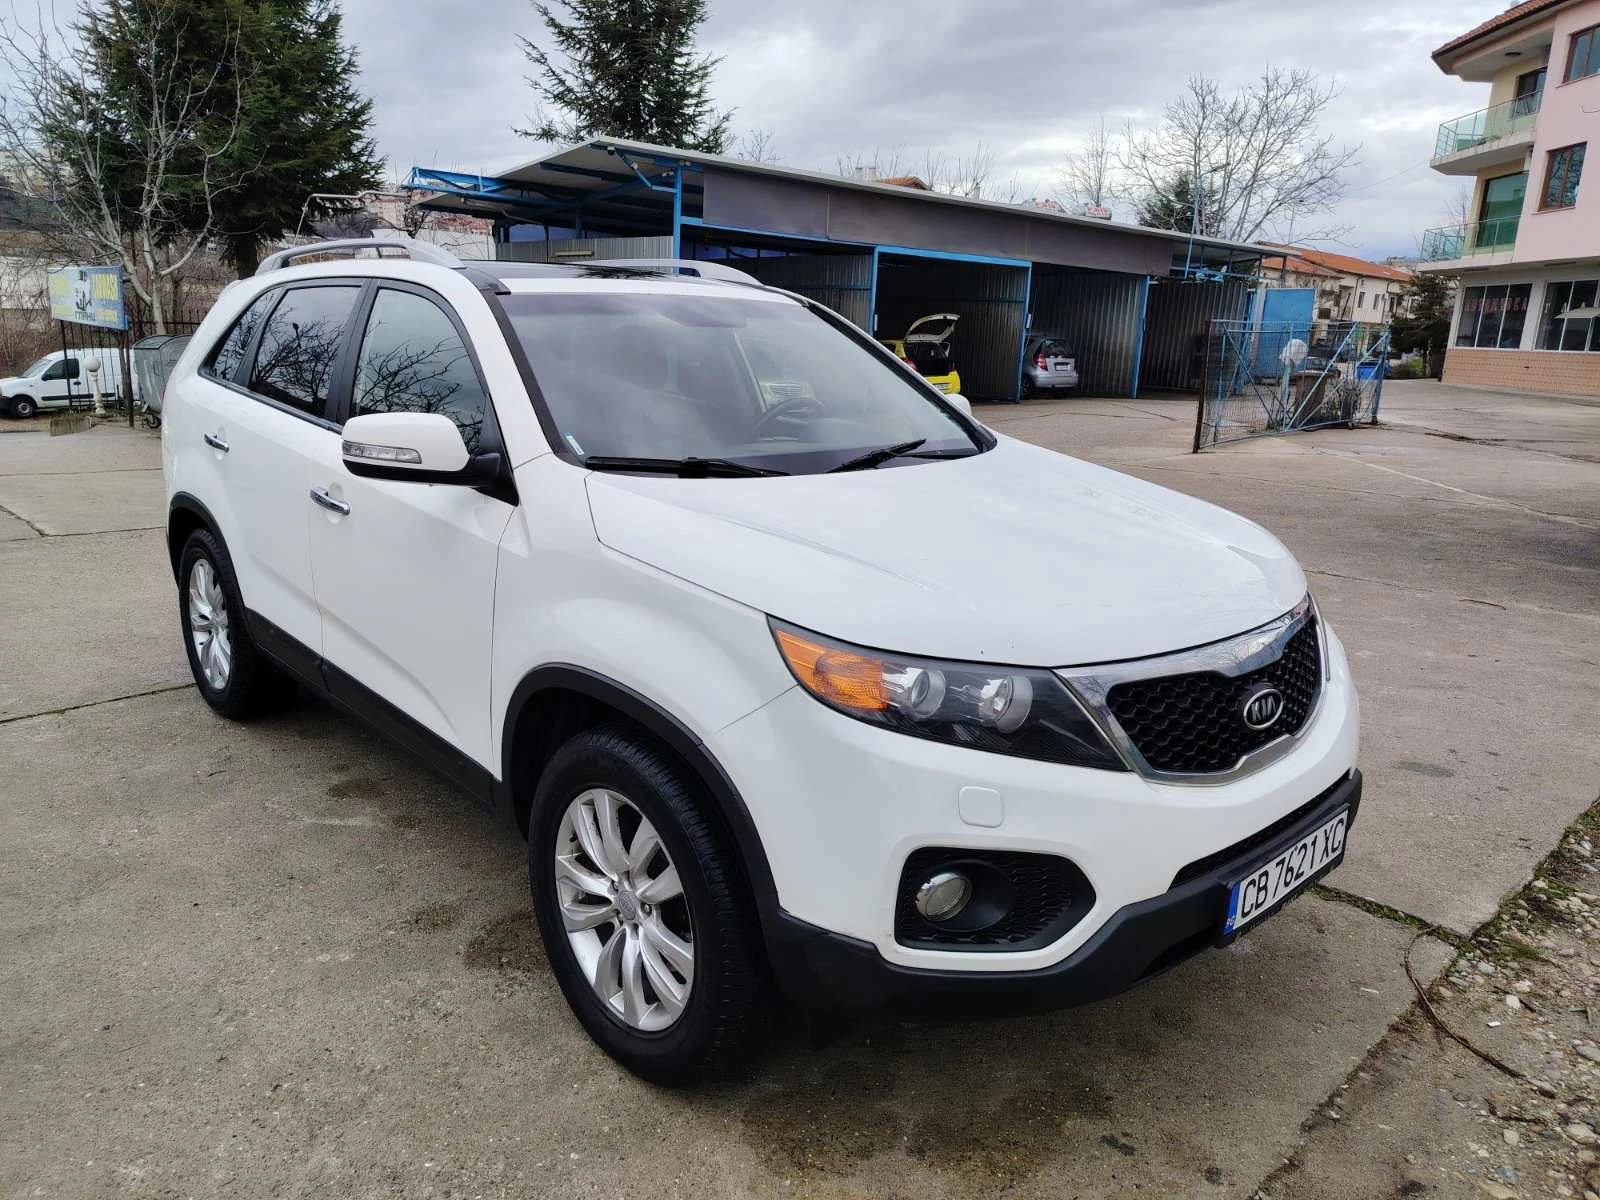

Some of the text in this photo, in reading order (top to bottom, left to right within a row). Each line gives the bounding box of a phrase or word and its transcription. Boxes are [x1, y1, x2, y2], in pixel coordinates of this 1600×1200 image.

[1251, 695, 1277, 721] KIA
[1240, 817, 1345, 919] CB 7621 XC
